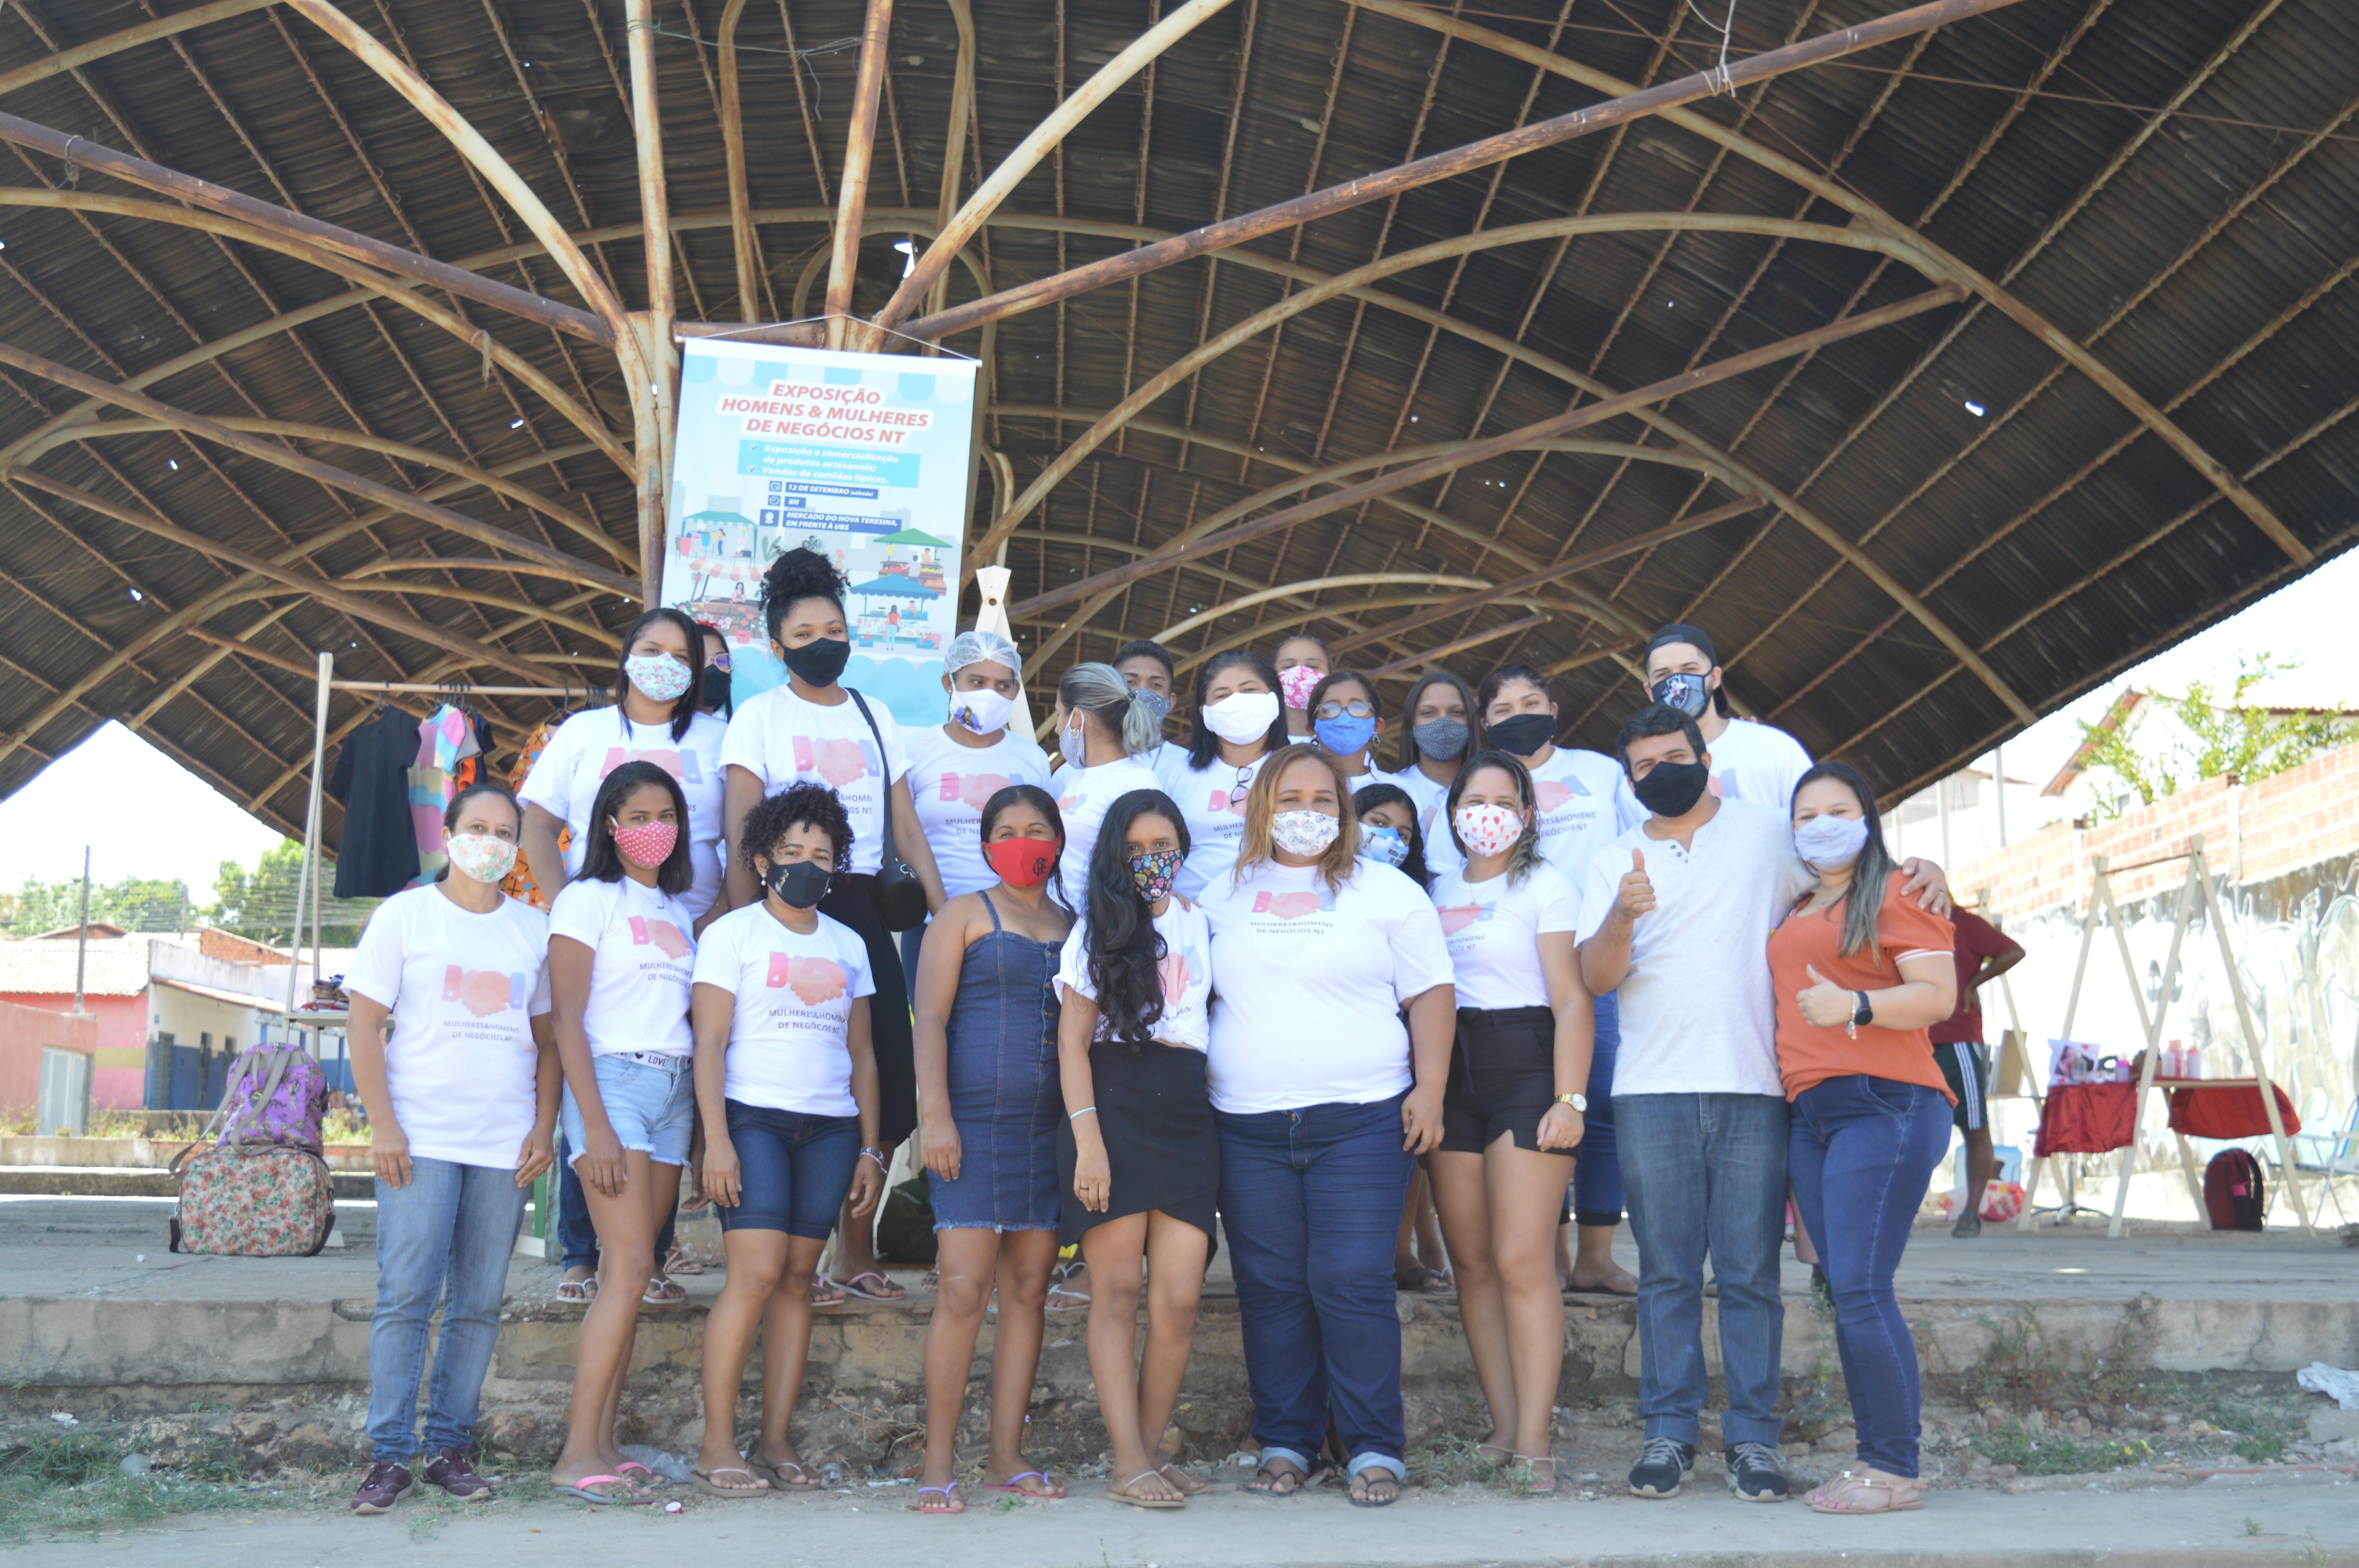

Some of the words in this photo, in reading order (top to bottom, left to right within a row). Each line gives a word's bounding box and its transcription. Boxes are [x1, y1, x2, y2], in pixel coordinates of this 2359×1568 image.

[773, 384, 881, 405] EXPOSIÇÃO
[722, 398, 805, 416] HOMENS
[808, 405, 822, 417] &
[827, 407, 929, 427] MULHERES
[746, 419, 772, 432] DE
[776, 421, 874, 441] NEGÓCIOS
[879, 430, 905, 444] NT
[764, 445, 812, 457] Exposição
[822, 450, 899, 463] comercialização
[776, 458, 821, 467] produtos
[822, 462, 876, 472] artesanais;
[763, 466, 797, 476] Vendas
[813, 471, 852, 481] comidas
[855, 474, 889, 484] típicas.
[810, 486, 850, 495] SETEMBRO
[786, 512, 824, 521] MERCADO
[861, 517, 898, 526] TERESINA,
[798, 521, 827, 529] FRENTE
[827, 521, 833, 529] À
[1213, 822, 1243, 831] MULHER
[1541, 824, 1575, 837] EGÓCIOS
[444, 1020, 520, 1033] MULHERES&HOMENS
[465, 1032, 503, 1040] NEGÓCIOS
[648, 1055, 667, 1066] LOVE
